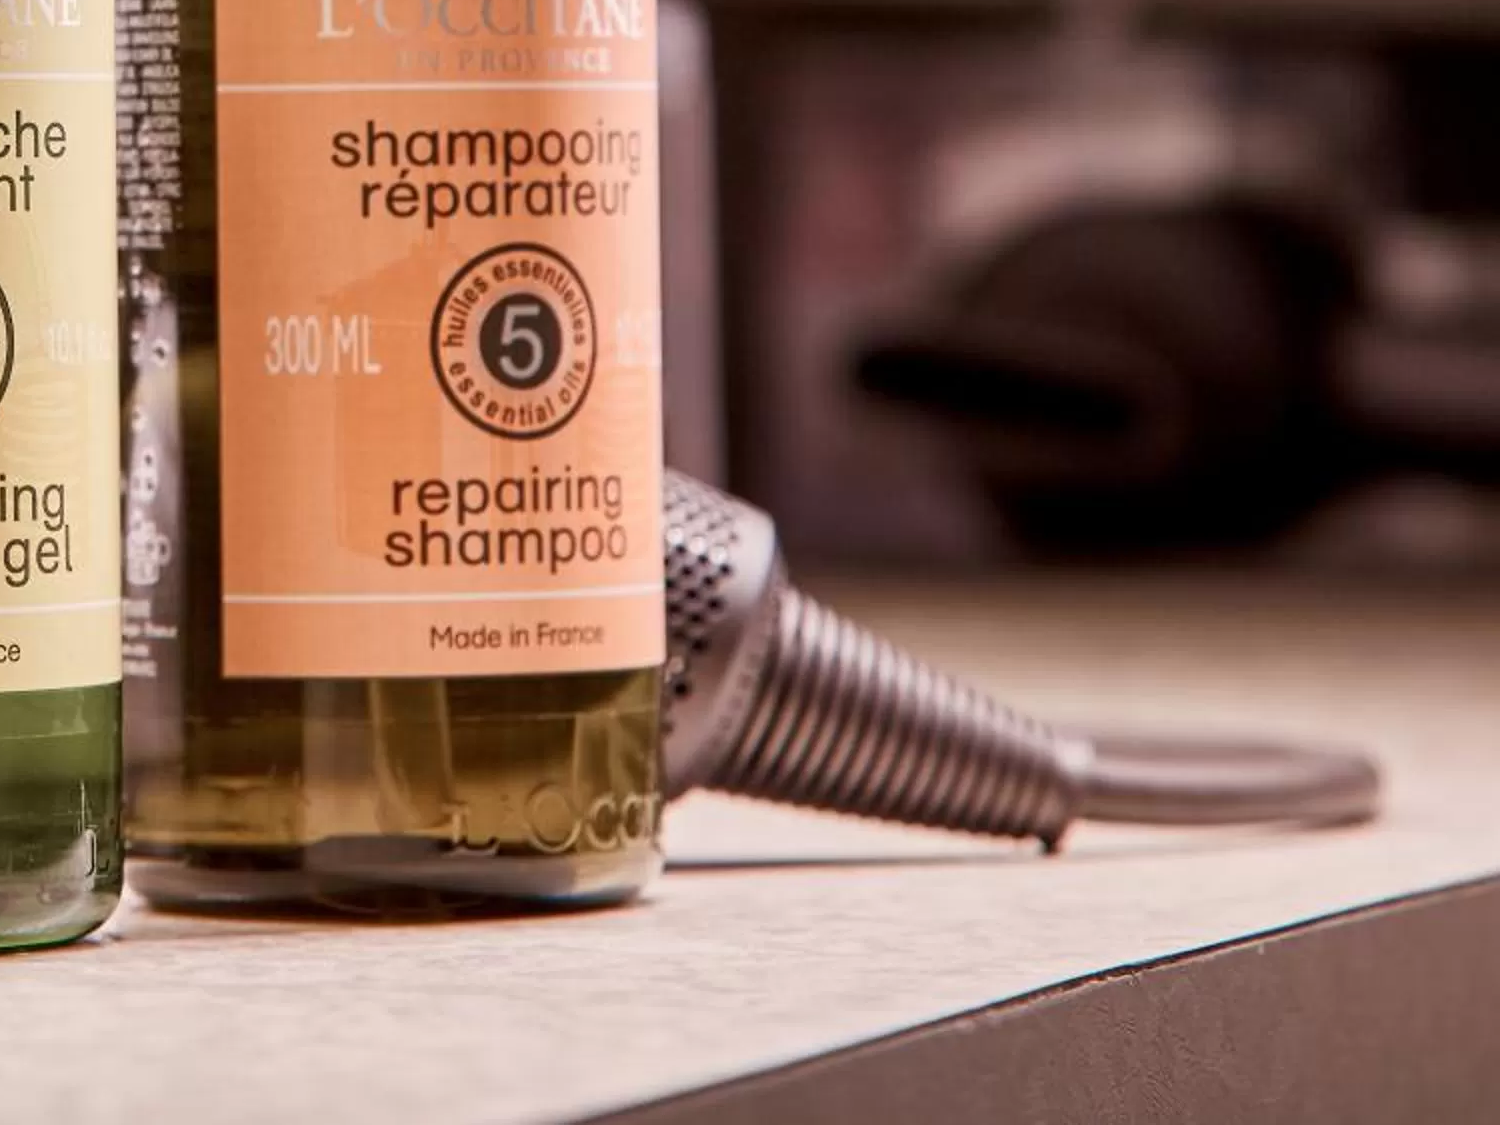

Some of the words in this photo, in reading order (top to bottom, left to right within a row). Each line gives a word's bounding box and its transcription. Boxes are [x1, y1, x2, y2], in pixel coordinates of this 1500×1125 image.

[331, 118, 641, 176] shampooing
[361, 169, 631, 229] réparateur
[442, 274, 489, 348] huiles
[264, 315, 322, 375] 300
[332, 315, 381, 374] ML
[499, 304, 545, 380] 5
[449, 360, 556, 427] essential
[392, 464, 623, 526] repairing
[2, 524, 73, 588] gel
[384, 519, 628, 575] shampoo
[429, 626, 502, 651] Made
[510, 625, 530, 648] in
[536, 622, 606, 647] France
